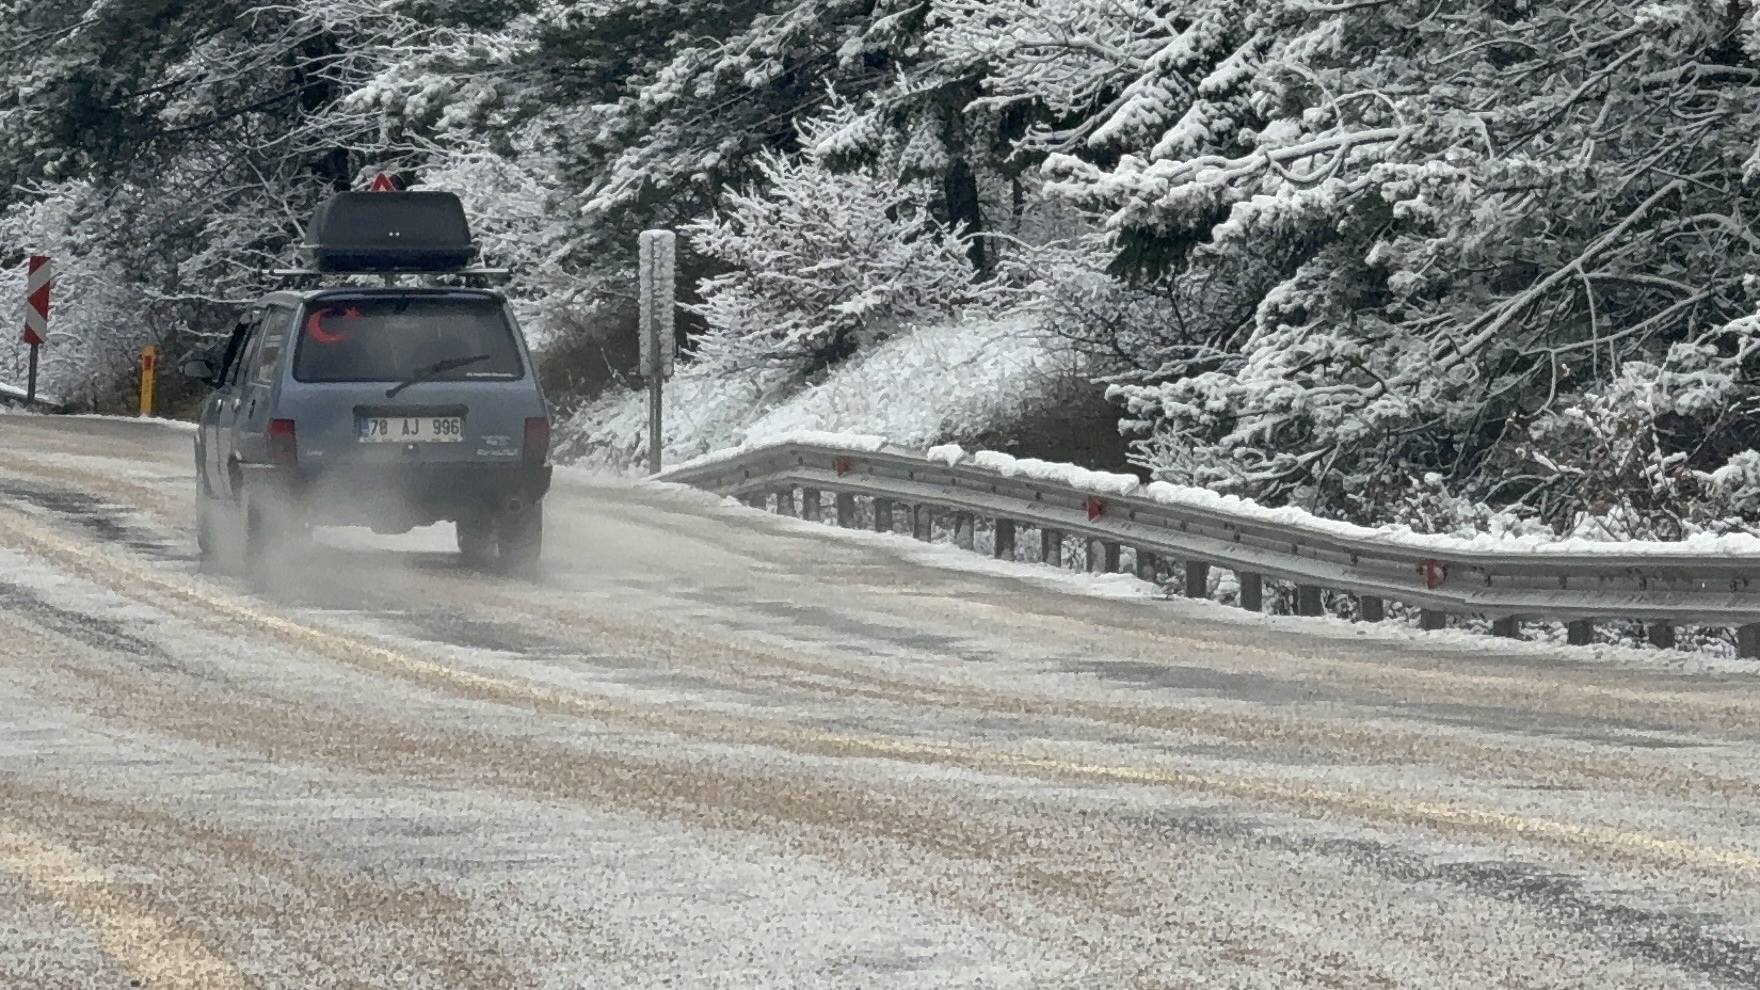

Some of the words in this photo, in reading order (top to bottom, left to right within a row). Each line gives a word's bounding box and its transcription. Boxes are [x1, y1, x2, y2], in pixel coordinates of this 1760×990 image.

[370, 419, 388, 436] 78
[401, 419, 419, 436] AJ
[433, 419, 460, 435] 996
